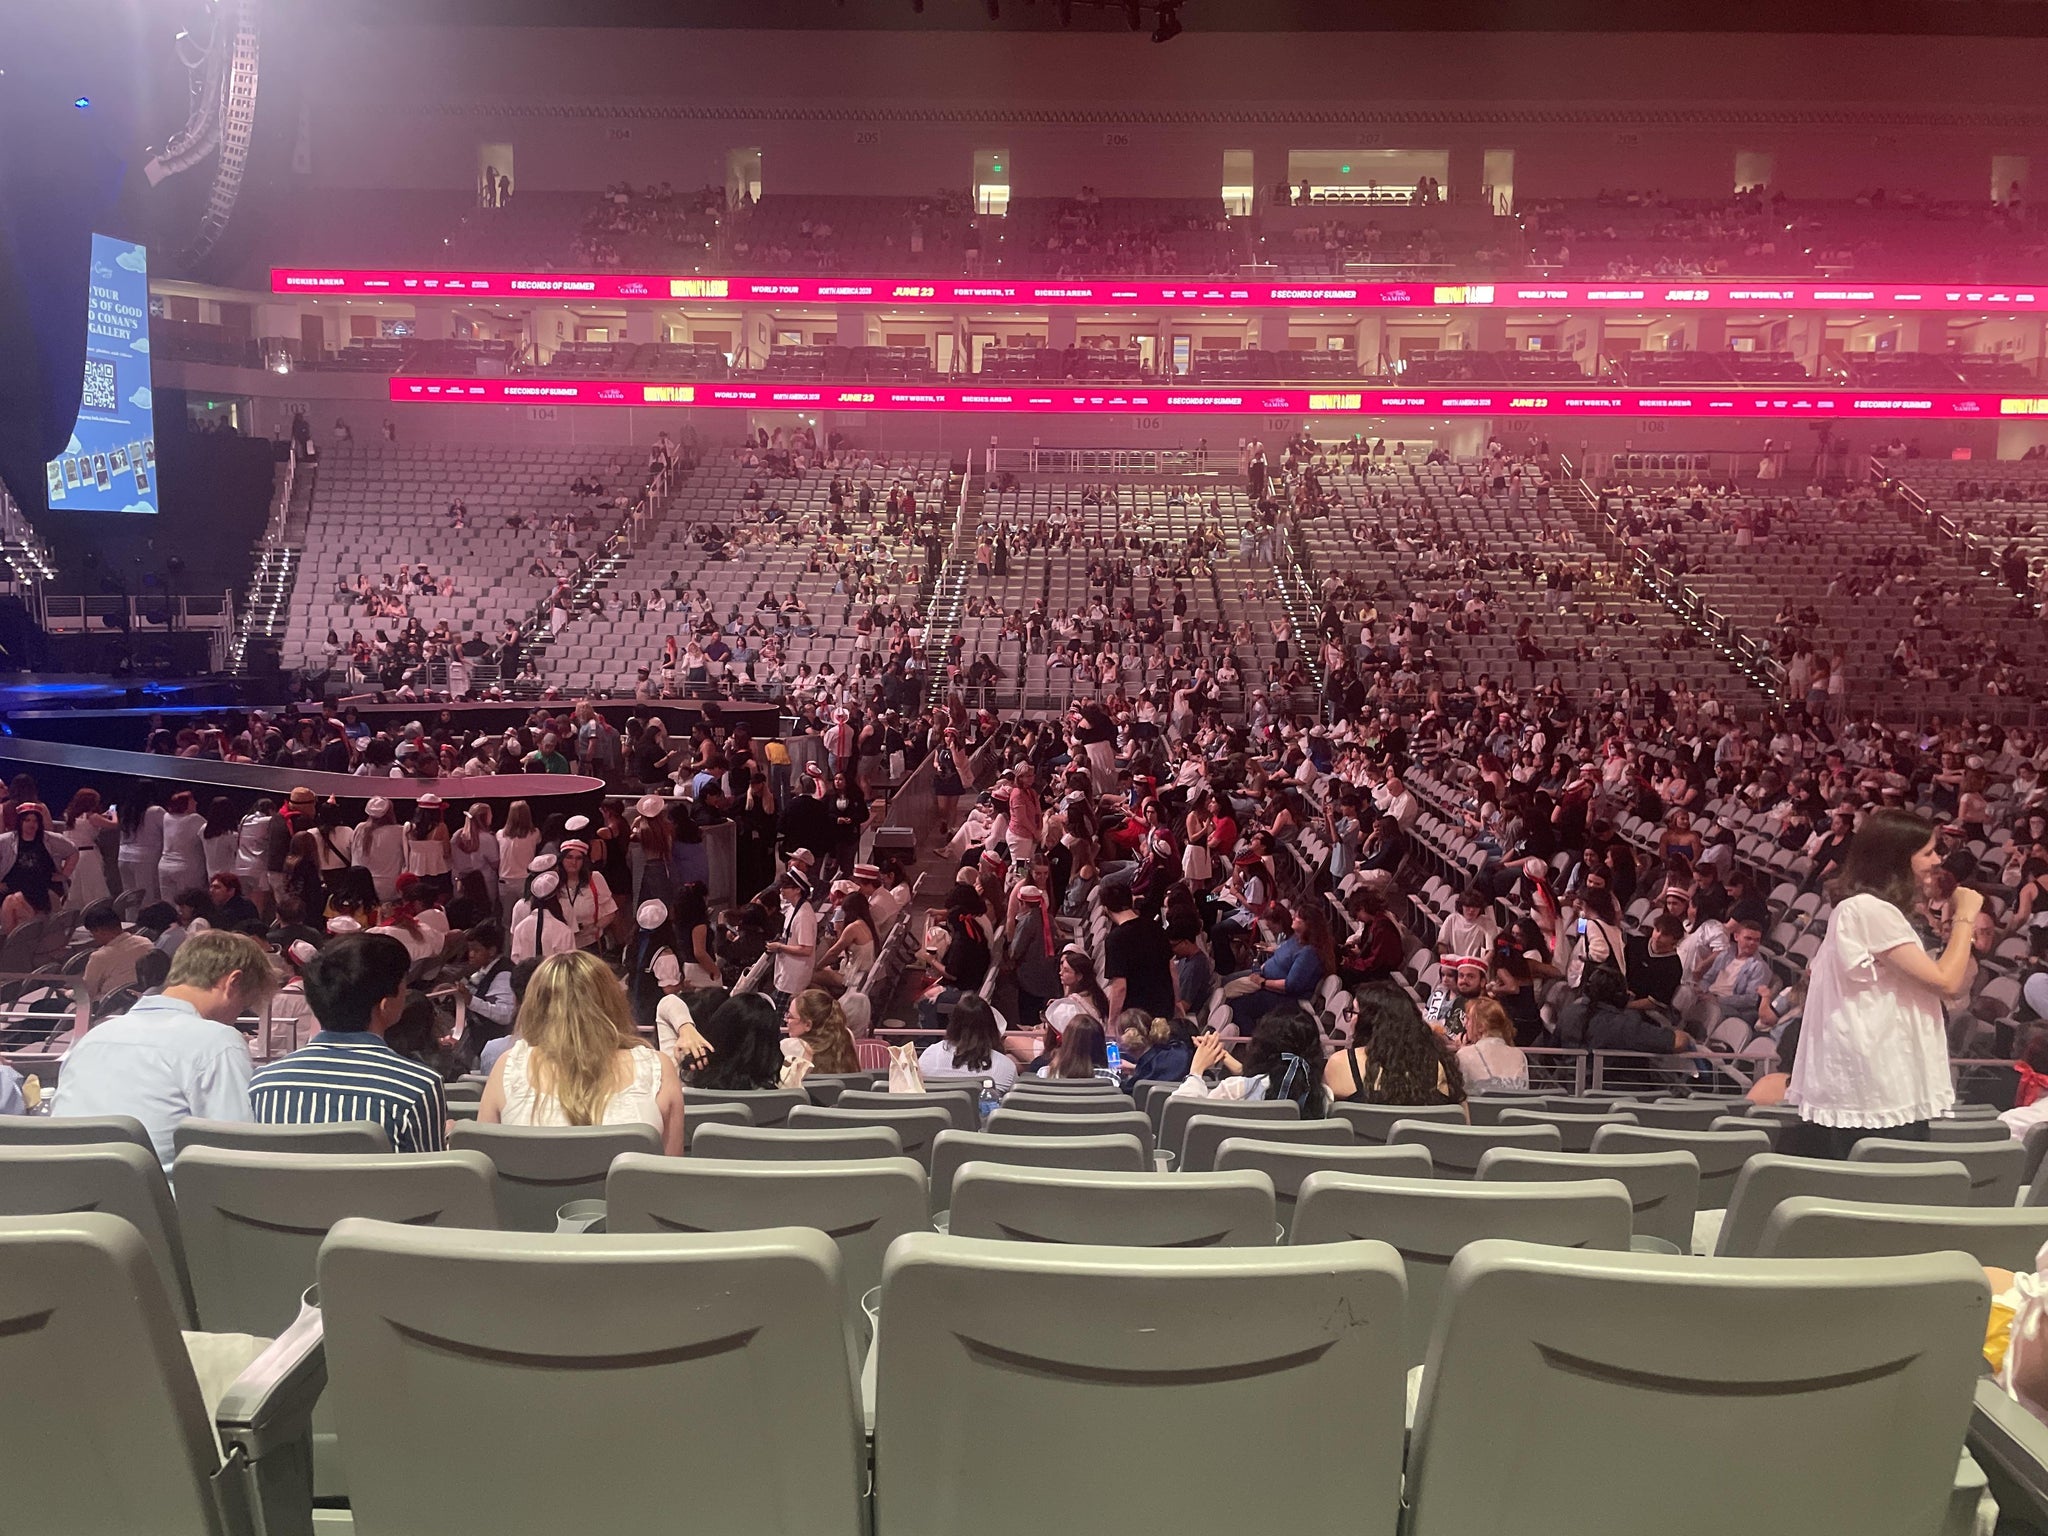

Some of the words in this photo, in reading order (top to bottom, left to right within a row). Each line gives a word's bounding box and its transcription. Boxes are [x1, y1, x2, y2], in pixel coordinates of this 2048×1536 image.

[857, 132, 878, 143] 205
[1107, 134, 1128, 145] 206
[1359, 134, 1380, 145] 207
[319, 278, 345, 286] ARENA
[517, 281, 552, 290] SECONDS
[552, 282, 563, 290] OF
[563, 282, 595, 291] SUMMER
[93, 286, 119, 301] YOUR
[779, 286, 799, 294] TOUR
[892, 287, 920, 297] JUNE
[920, 287, 934, 297] 23
[974, 289, 1004, 297] WORTH,
[1277, 290, 1312, 299] SECONDS
[1313, 290, 1324, 299] OF
[1324, 290, 1356, 298] SUMMER
[1546, 291, 1568, 299] TOUR
[1665, 290, 1694, 300] JUNE
[100, 301, 113, 312] OF
[115, 303, 143, 318] GOOD
[97, 312, 138, 330] CONAN'S
[89, 323, 131, 340] GALLERY
[509, 387, 540, 396] SECONDS
[540, 388, 550, 396] OF
[550, 388, 577, 396] SUMMER
[838, 393, 862, 402] JUNE
[862, 394, 874, 402] 23
[1173, 397, 1204, 405] SECONDS
[284, 403, 306, 415] 103
[1509, 399, 1535, 408] JUNE
[1535, 399, 1548, 408] 23
[532, 408, 554, 419] 104
[1136, 417, 1160, 429] 106
[1269, 419, 1290, 430] 107
[1508, 420, 1530, 431] 107
[1642, 420, 1665, 432] 108
